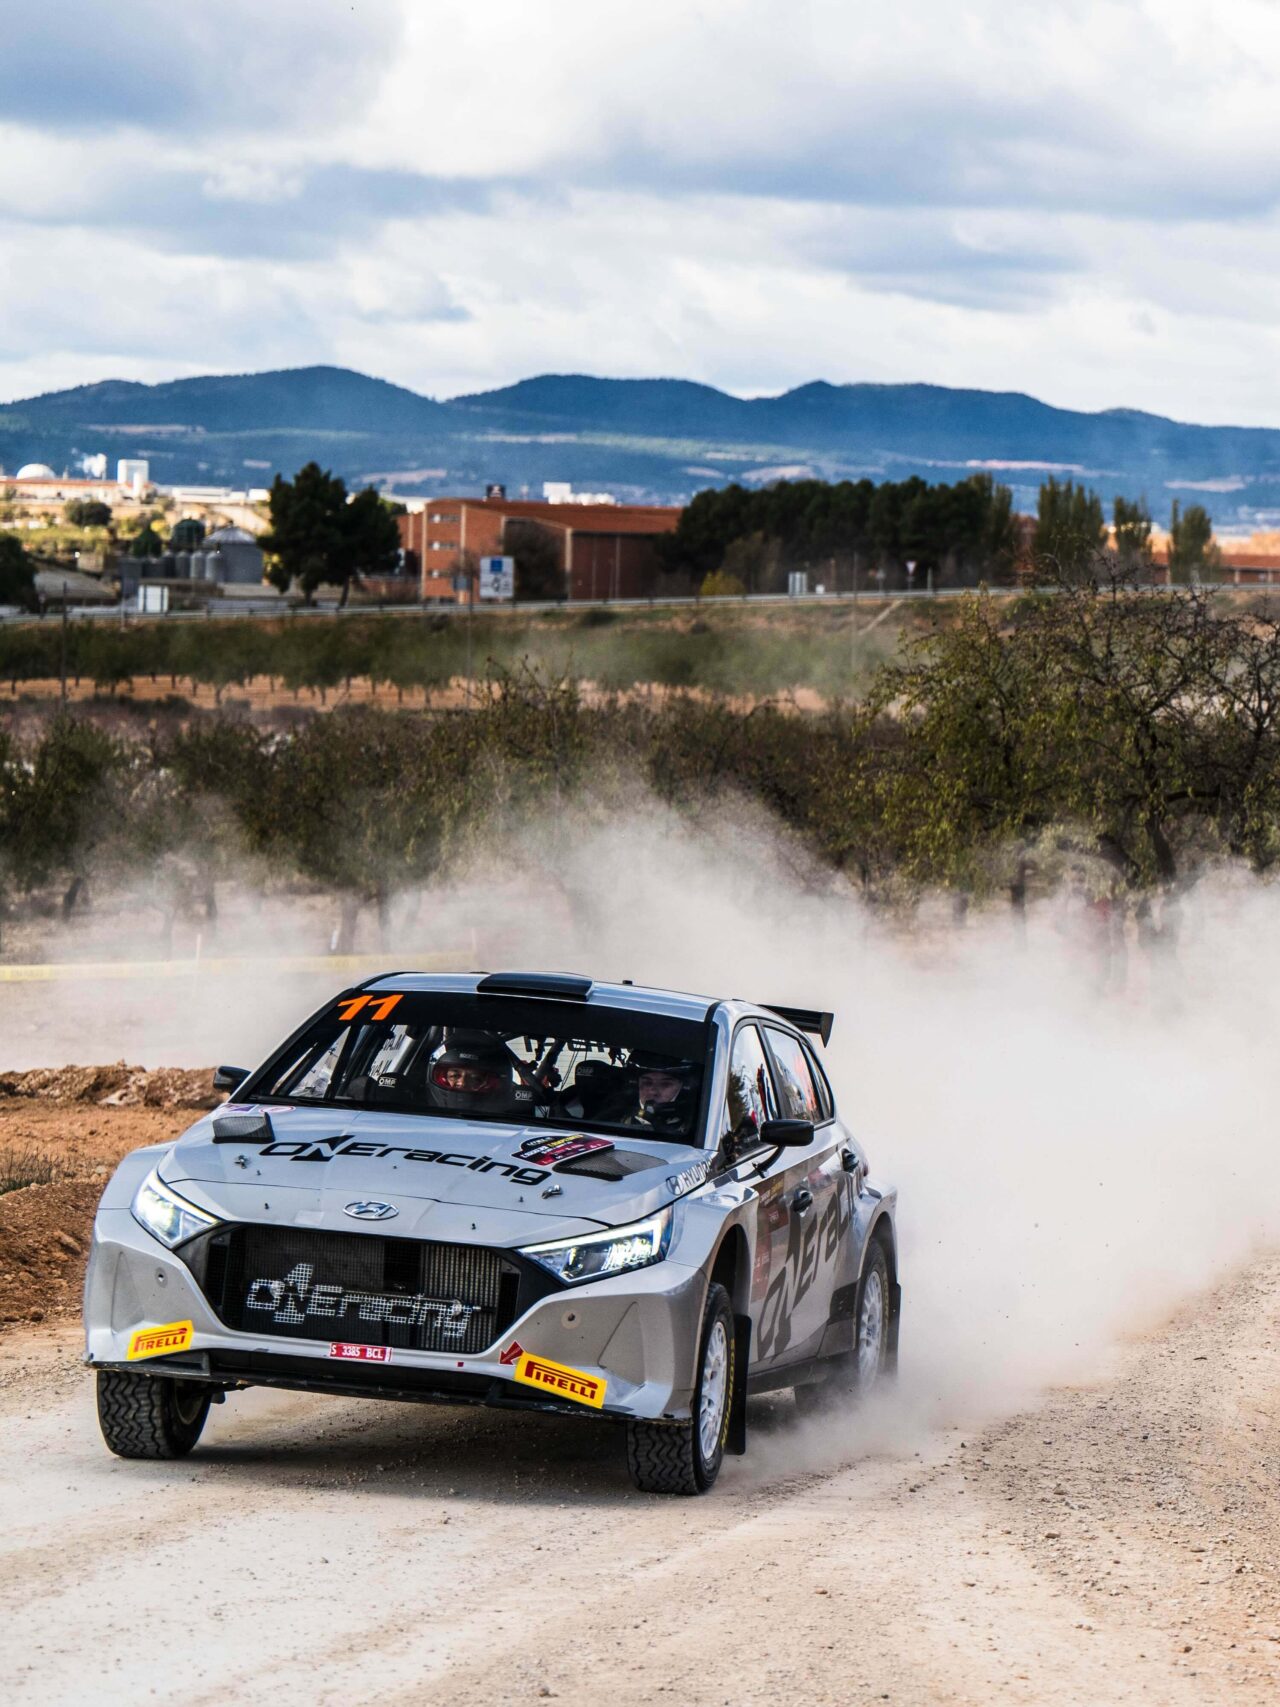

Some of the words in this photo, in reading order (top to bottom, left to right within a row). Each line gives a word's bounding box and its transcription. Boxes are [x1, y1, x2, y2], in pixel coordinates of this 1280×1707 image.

[337, 993, 405, 1021] 11
[378, 1076, 397, 1088] OMP
[514, 1090, 533, 1101] OMP
[133, 1327, 188, 1353] PIRELLI
[331, 1344, 337, 1355] S
[342, 1345, 361, 1357] 3385
[365, 1347, 384, 1359] BCL
[524, 1360, 599, 1400] PIRELLI
